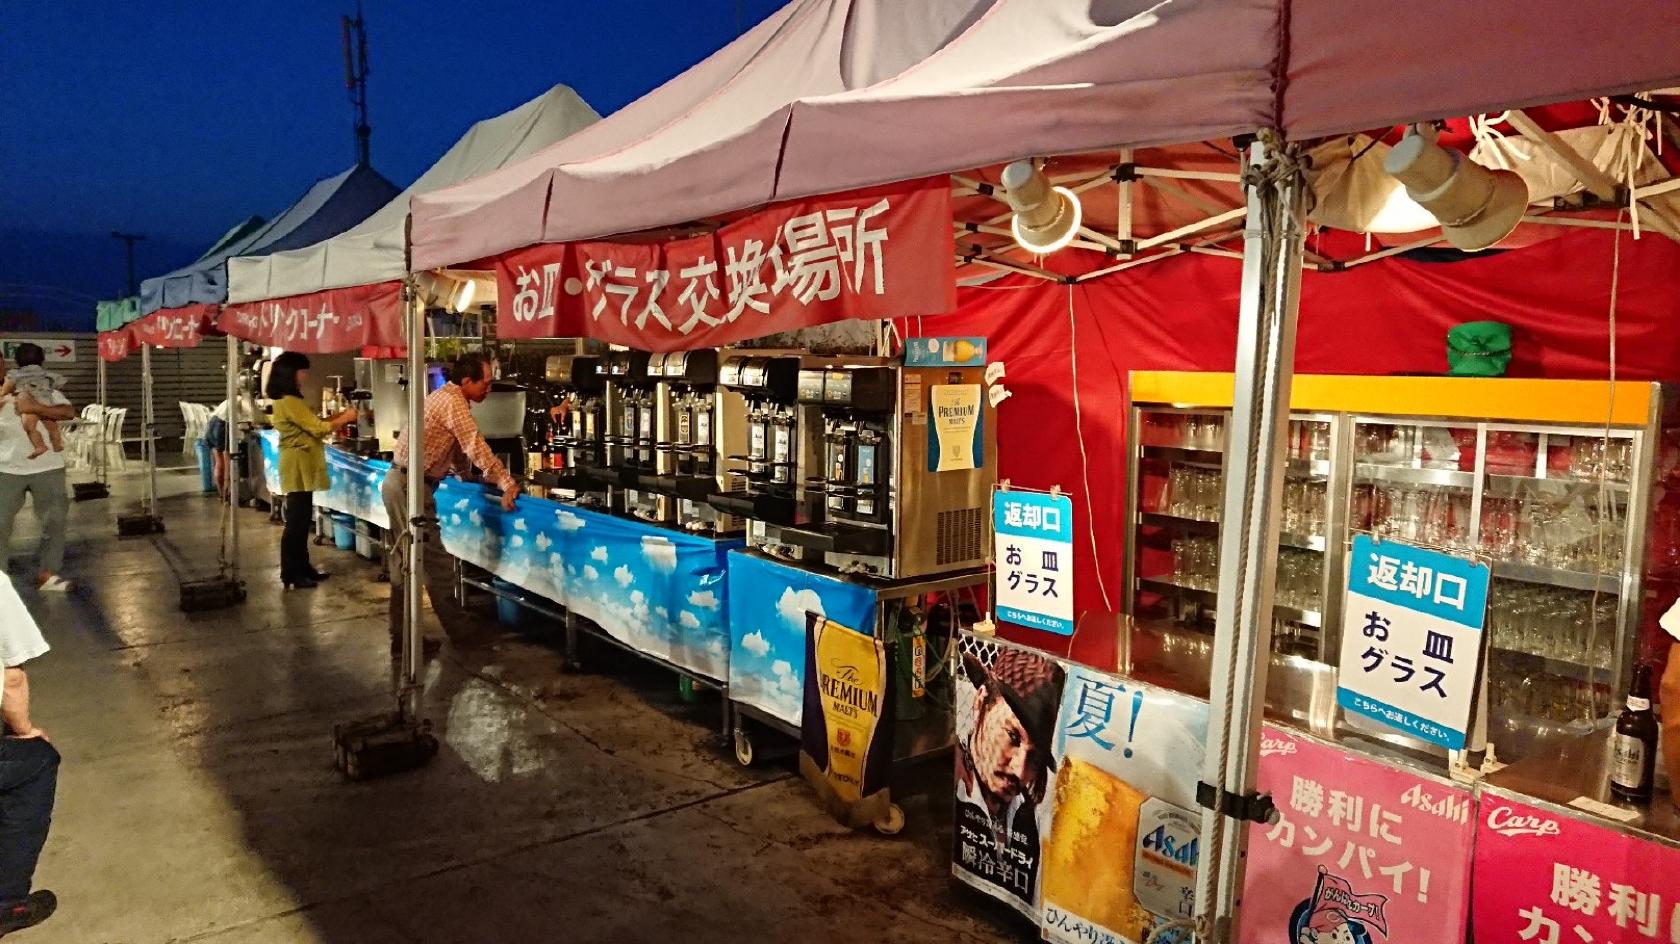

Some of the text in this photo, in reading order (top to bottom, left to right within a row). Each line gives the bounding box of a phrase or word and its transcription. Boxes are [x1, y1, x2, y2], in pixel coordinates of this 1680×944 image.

[938, 404, 975, 418] PREMIUM
[1003, 501, 1061, 533] 返却口
[1007, 570, 1059, 598] グラス
[1367, 552, 1468, 611] 返却口
[1360, 645, 1448, 699] グラス
[820, 672, 879, 718] REMIUM
[1290, 775, 1402, 846] 勝利に
[1401, 783, 1470, 826] Asahi
[1487, 806, 1561, 838] Carp
[1142, 824, 1199, 866] Asah
[1550, 862, 1680, 944] 勝利
